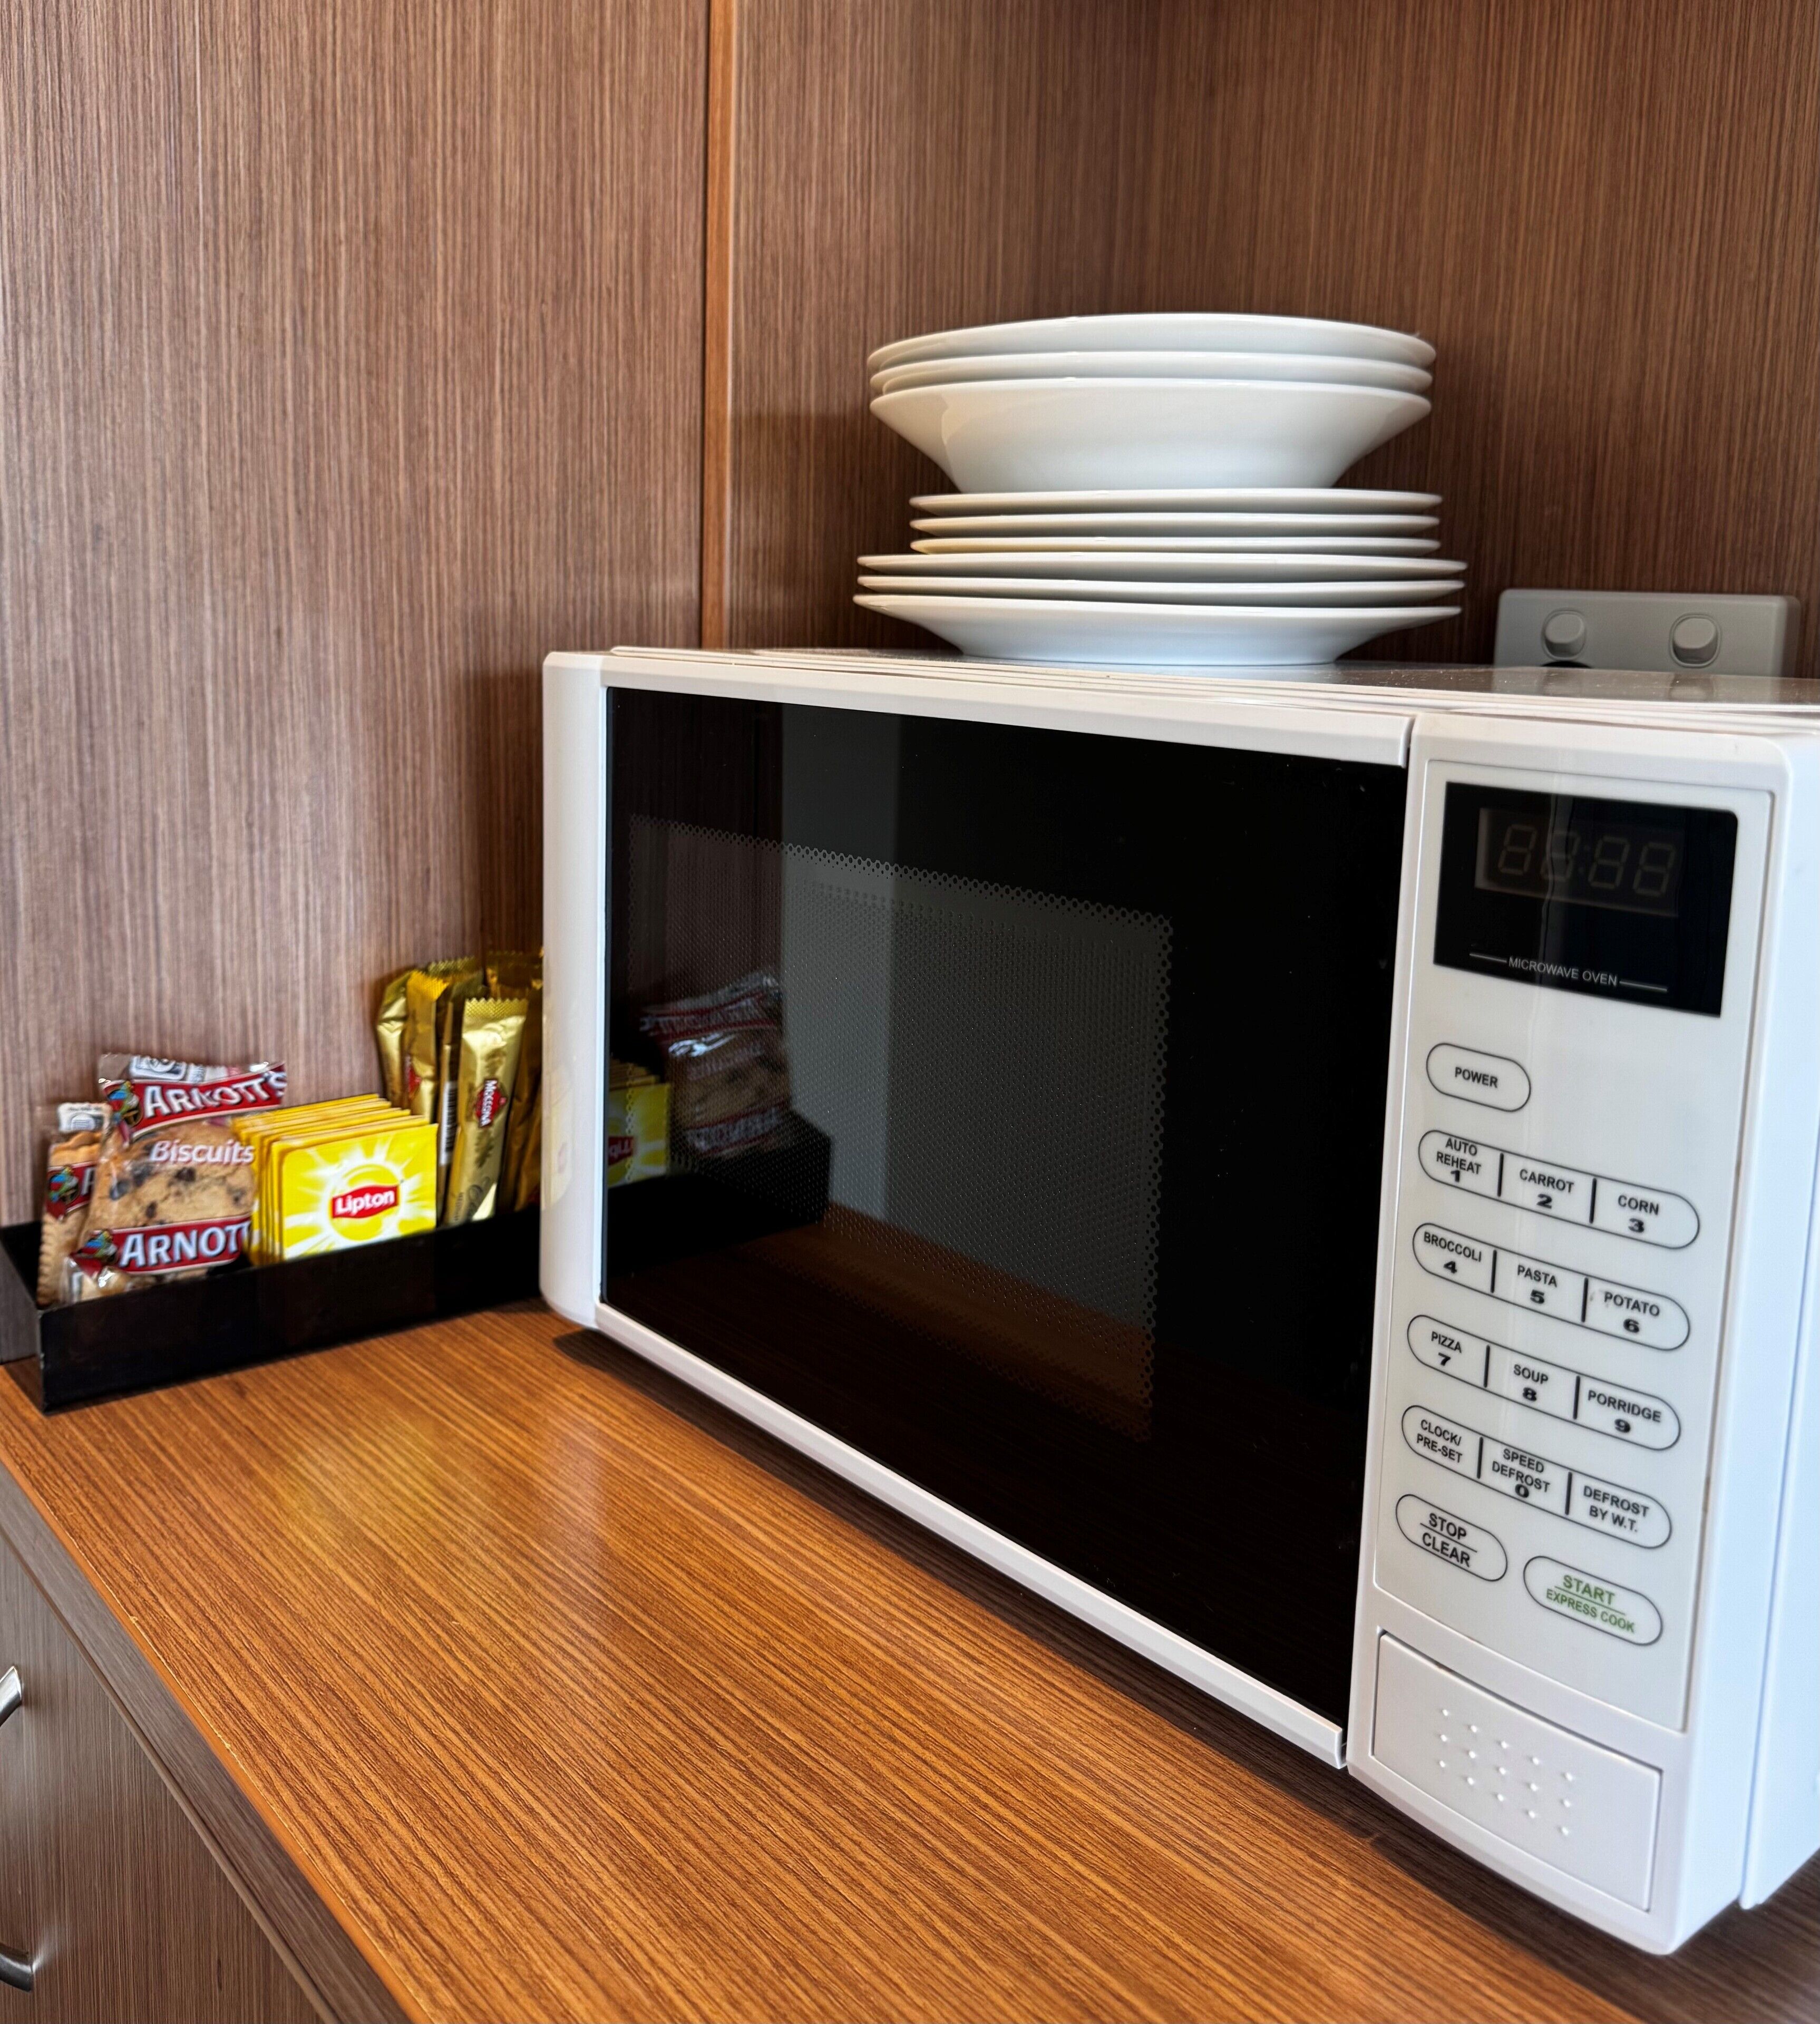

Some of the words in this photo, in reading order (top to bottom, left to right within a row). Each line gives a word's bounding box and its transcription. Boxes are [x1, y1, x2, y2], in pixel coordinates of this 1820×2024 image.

[1508, 956, 1579, 980] MICROWAVE
[1582, 970, 1618, 987] OVEN
[1455, 1066, 1498, 1088] POWER
[150, 1138, 255, 1165] Biscuits
[1445, 1137, 1478, 1156] AUTO
[1436, 1151, 1482, 1175] REHEAT
[1451, 1170, 1462, 1183] 1
[1519, 1169, 1574, 1194] CARROT
[334, 1190, 395, 1216] Lipton
[1536, 1194, 1553, 1209] 2
[1617, 1195, 1660, 1215] CORN
[1628, 1218, 1645, 1233] 3
[1423, 1231, 1482, 1263] BROCCOLI
[1443, 1260, 1458, 1274] 4
[1517, 1264, 1558, 1288] PASTA
[1530, 1291, 1545, 1305] 5
[1604, 1291, 1660, 1317] POTATO
[1623, 1319, 1640, 1334] 6
[1430, 1331, 1462, 1354] PIZZA
[1437, 1353, 1452, 1367] 7
[1513, 1364, 1549, 1385] SOUP
[1522, 1387, 1537, 1402] 8
[1587, 1389, 1662, 1423] PORRIDGE
[1420, 1419, 1462, 1446] CLOCK/
[1614, 1418, 1631, 1434] 9
[1416, 1433, 1463, 1464] PRE-SET
[1502, 1447, 1545, 1474] SPEED
[1492, 1461, 1551, 1494] DEFROST
[1583, 1485, 1650, 1518] DEFROST
[1428, 1512, 1467, 1541] STOP
[1589, 1505, 1608, 1522] BY
[1611, 1512, 1638, 1532] W.T.
[1422, 1532, 1471, 1568] CLEAR
[1562, 1574, 1616, 1605] START
[1546, 1588, 1599, 1618] EXPRESS
[1600, 1610, 1636, 1633] COOK
